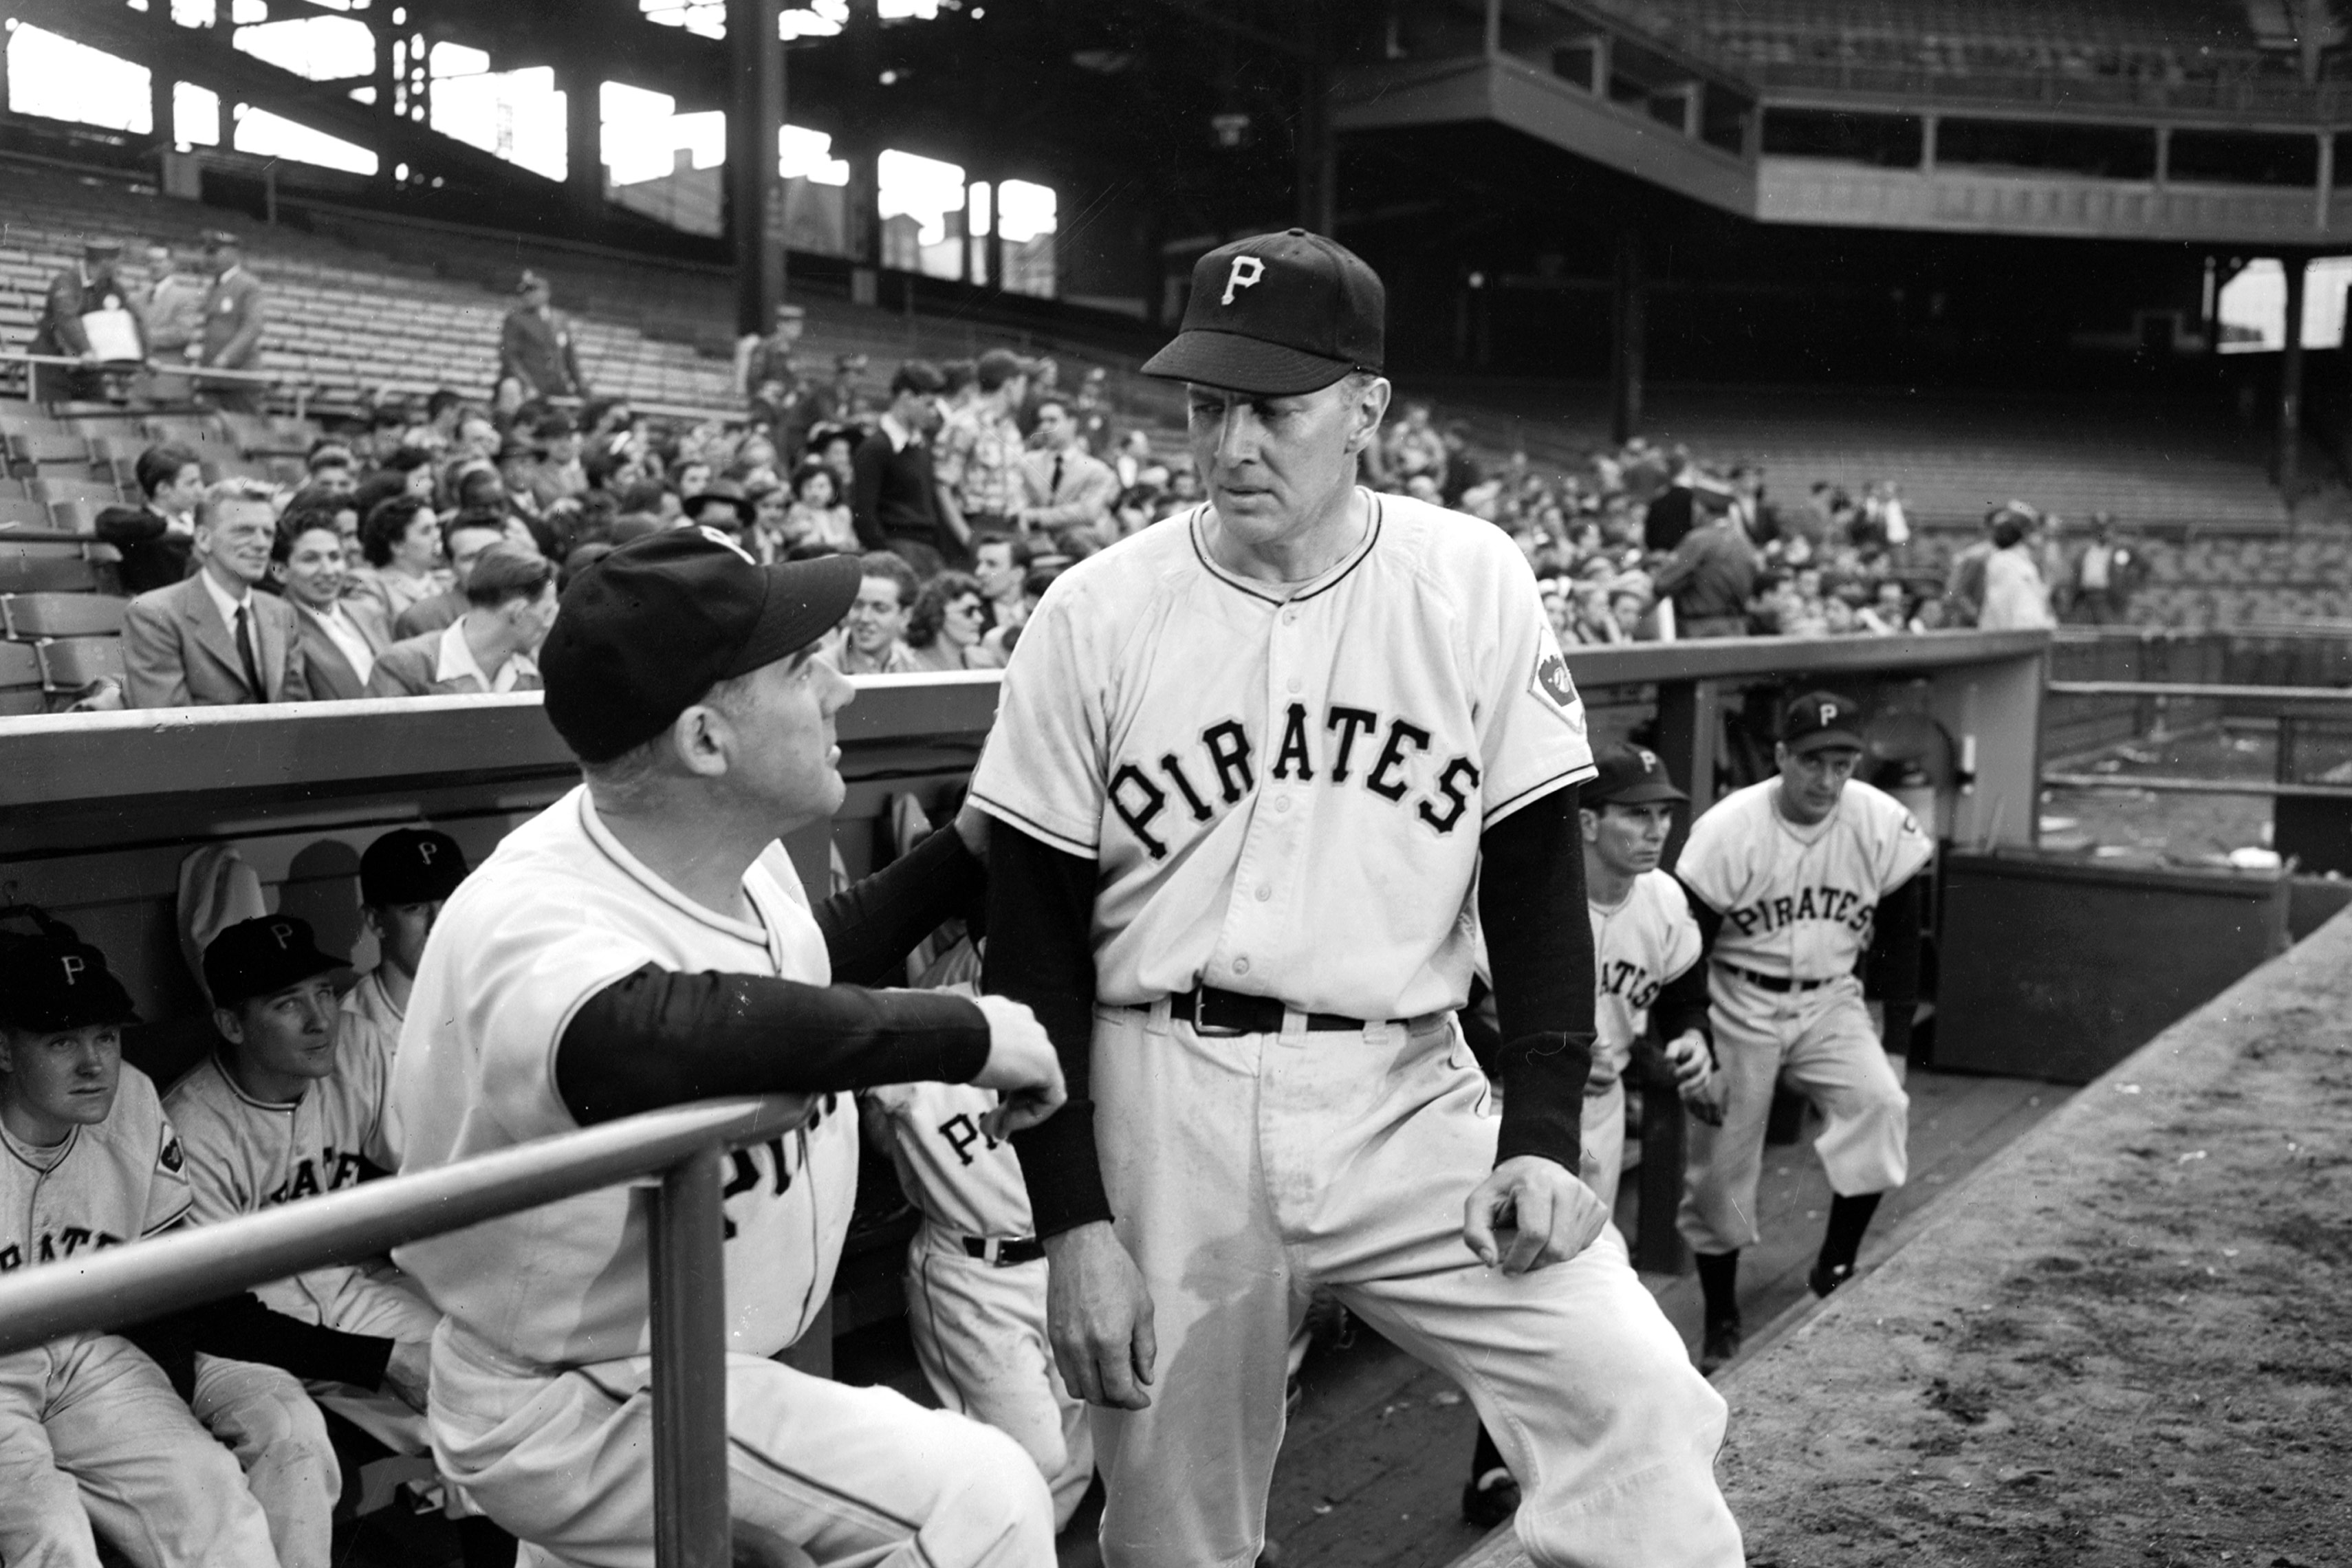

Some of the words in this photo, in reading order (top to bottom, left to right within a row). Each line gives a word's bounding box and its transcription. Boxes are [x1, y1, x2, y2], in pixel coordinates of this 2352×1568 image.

[1221, 255, 1265, 305] P
[1820, 704, 1837, 727] P
[1640, 750, 1656, 773] P
[1108, 703, 1479, 860] PIRATES
[419, 842, 437, 864] P
[1730, 886, 1876, 936] PIRATES
[271, 924, 292, 949] P
[61, 956, 85, 985] P
